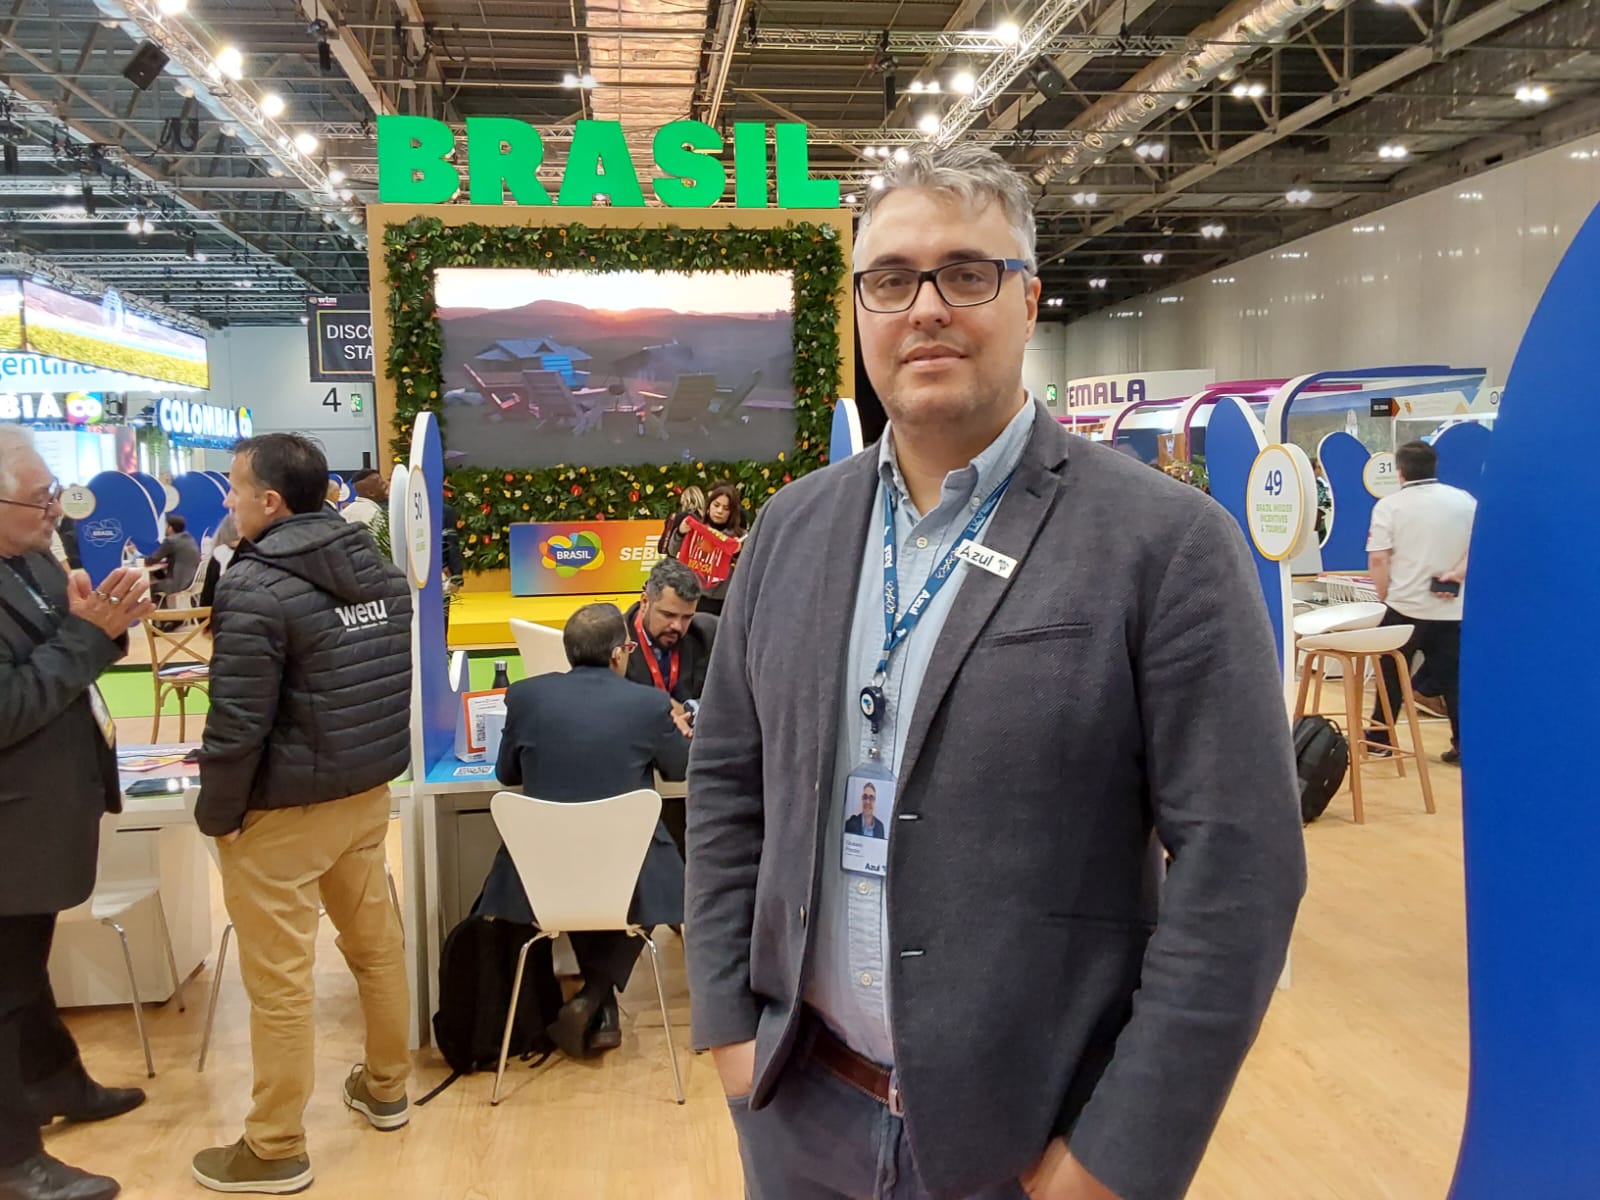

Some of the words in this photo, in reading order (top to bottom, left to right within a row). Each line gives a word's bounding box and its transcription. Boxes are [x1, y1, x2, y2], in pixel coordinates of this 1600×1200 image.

[376, 115, 840, 208] BRASIL
[322, 387, 342, 412] 4
[1067, 379, 1146, 407] EMALA
[160, 397, 238, 438] COLOMBIA
[1379, 462, 1392, 473] 31
[1265, 470, 1282, 496] 49
[72, 493, 83, 501] 13
[556, 550, 592, 560] BRASIL
[960, 545, 994, 567] Azul
[335, 600, 388, 626] wetu
[909, 589, 931, 615] Azul
[865, 863, 880, 871] Azul
